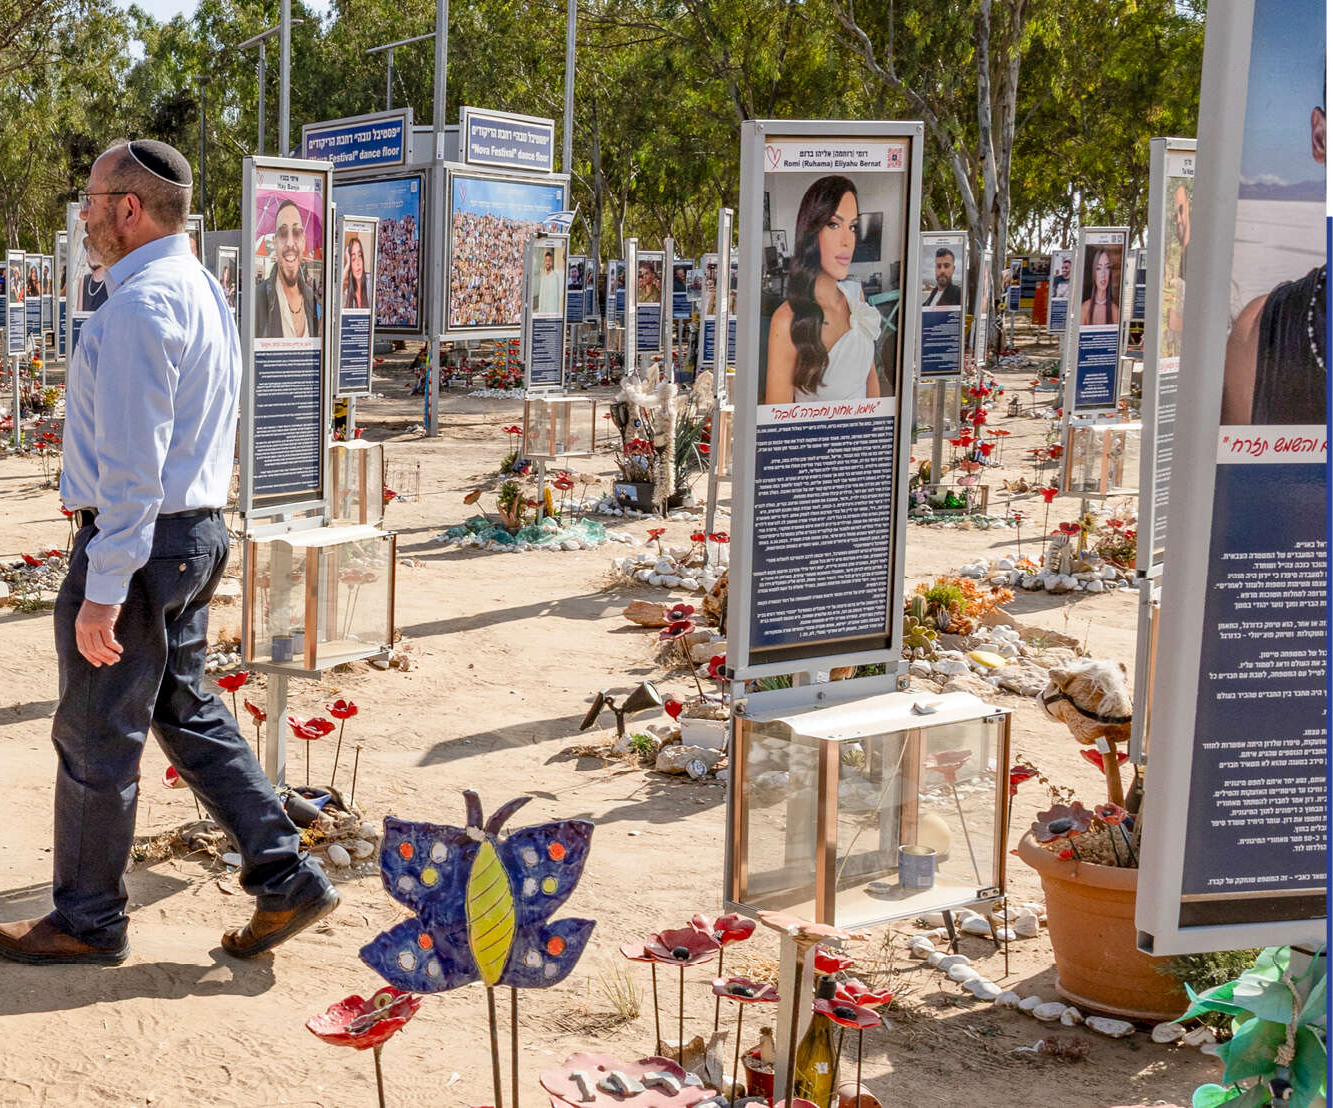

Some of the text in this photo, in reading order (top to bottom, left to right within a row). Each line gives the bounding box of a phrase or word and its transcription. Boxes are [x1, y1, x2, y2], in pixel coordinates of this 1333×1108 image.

[308, 137, 335, 150] הריקודים
[336, 134, 353, 145] רחבת
[329, 150, 359, 163] Festival"
[359, 150, 381, 160] dance
[382, 146, 399, 156] floor
[471, 144, 549, 162] "Nova Festival" dance floor
[802, 160, 833, 168] (Ruhama)
[834, 160, 858, 168] Eliyahu
[771, 405, 801, 421] טובה"
[800, 406, 830, 419] וחברה
[829, 405, 853, 419] אחות
[1273, 436, 1319, 454] והשמש
